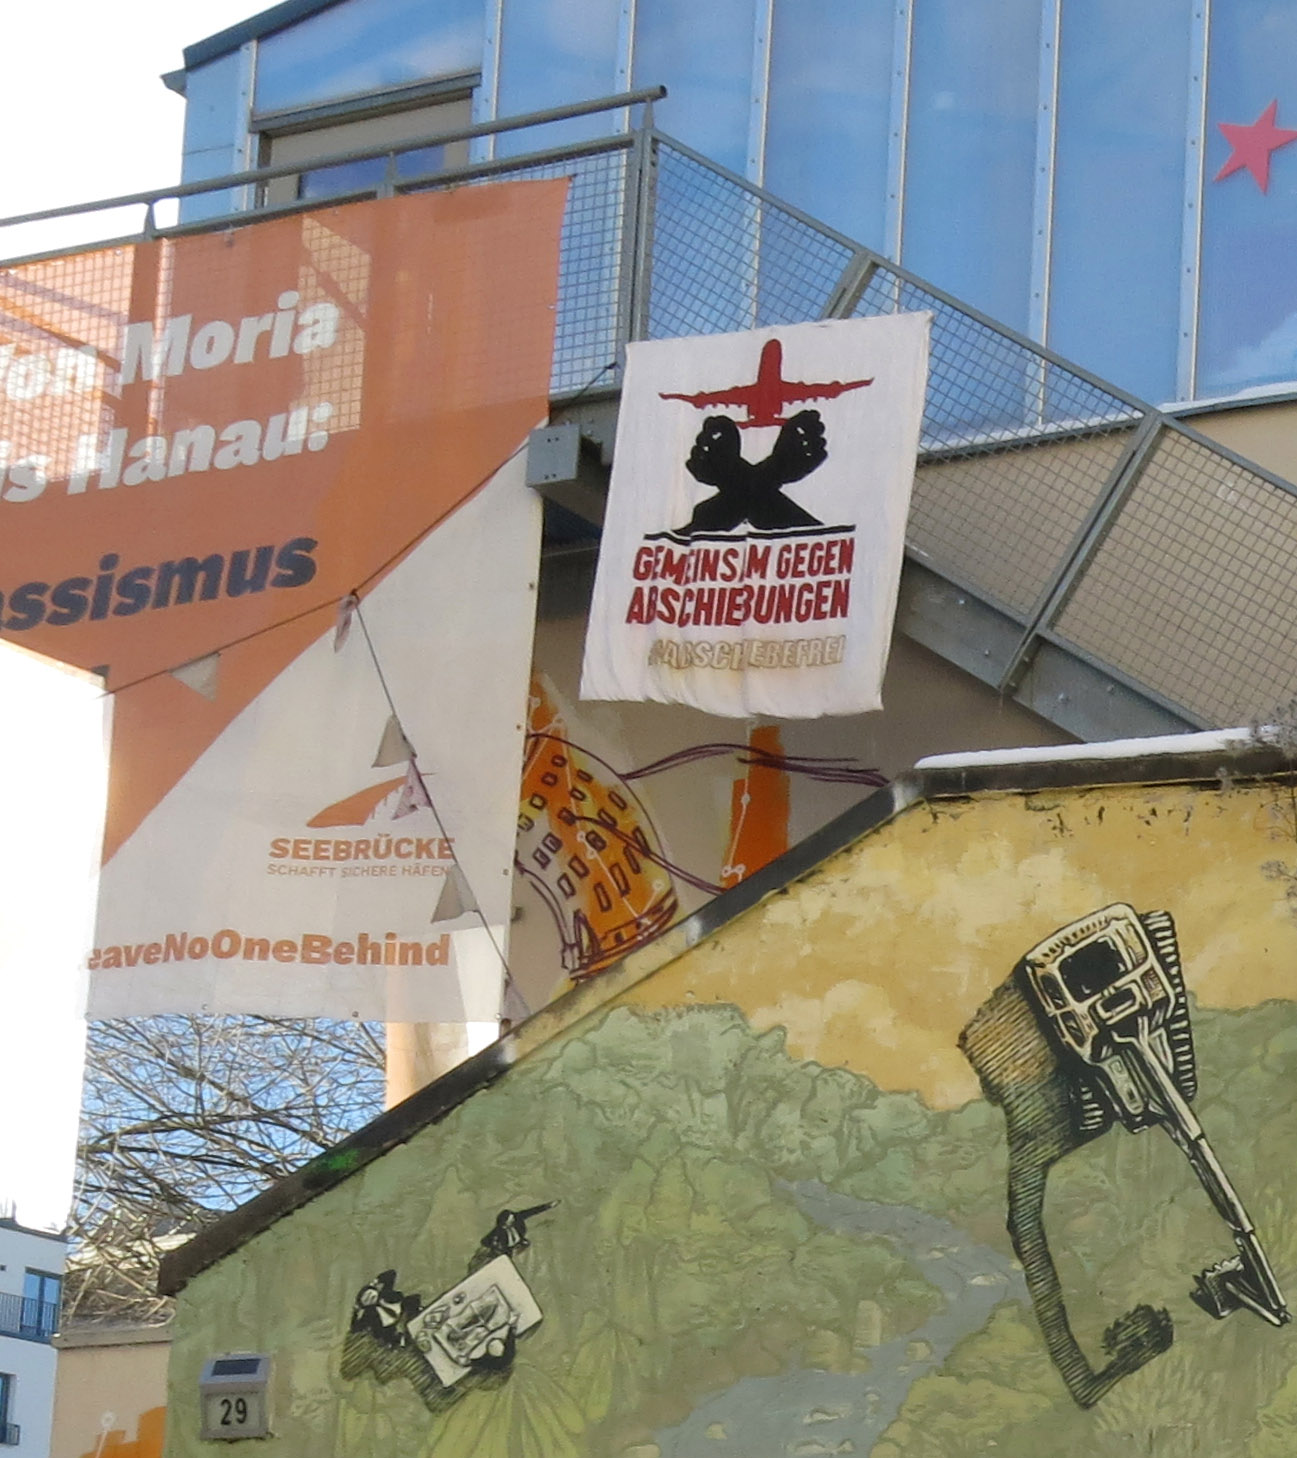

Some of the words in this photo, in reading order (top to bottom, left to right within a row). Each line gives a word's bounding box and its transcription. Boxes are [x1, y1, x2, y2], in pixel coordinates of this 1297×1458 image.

[119, 290, 340, 386] Moria
[67, 402, 333, 495] Hanau:
[776, 537, 855, 580] GEGEN
[0, 536, 318, 631] ssismus
[626, 579, 850, 628] ABSCHIEBUNGEN
[267, 863, 336, 879] SCHAFFT
[340, 864, 397, 879] SICHERE
[402, 861, 451, 878] HÄFEN
[268, 832, 455, 862] SEEBRÜCKE
[220, 1398, 248, 1426] 29
